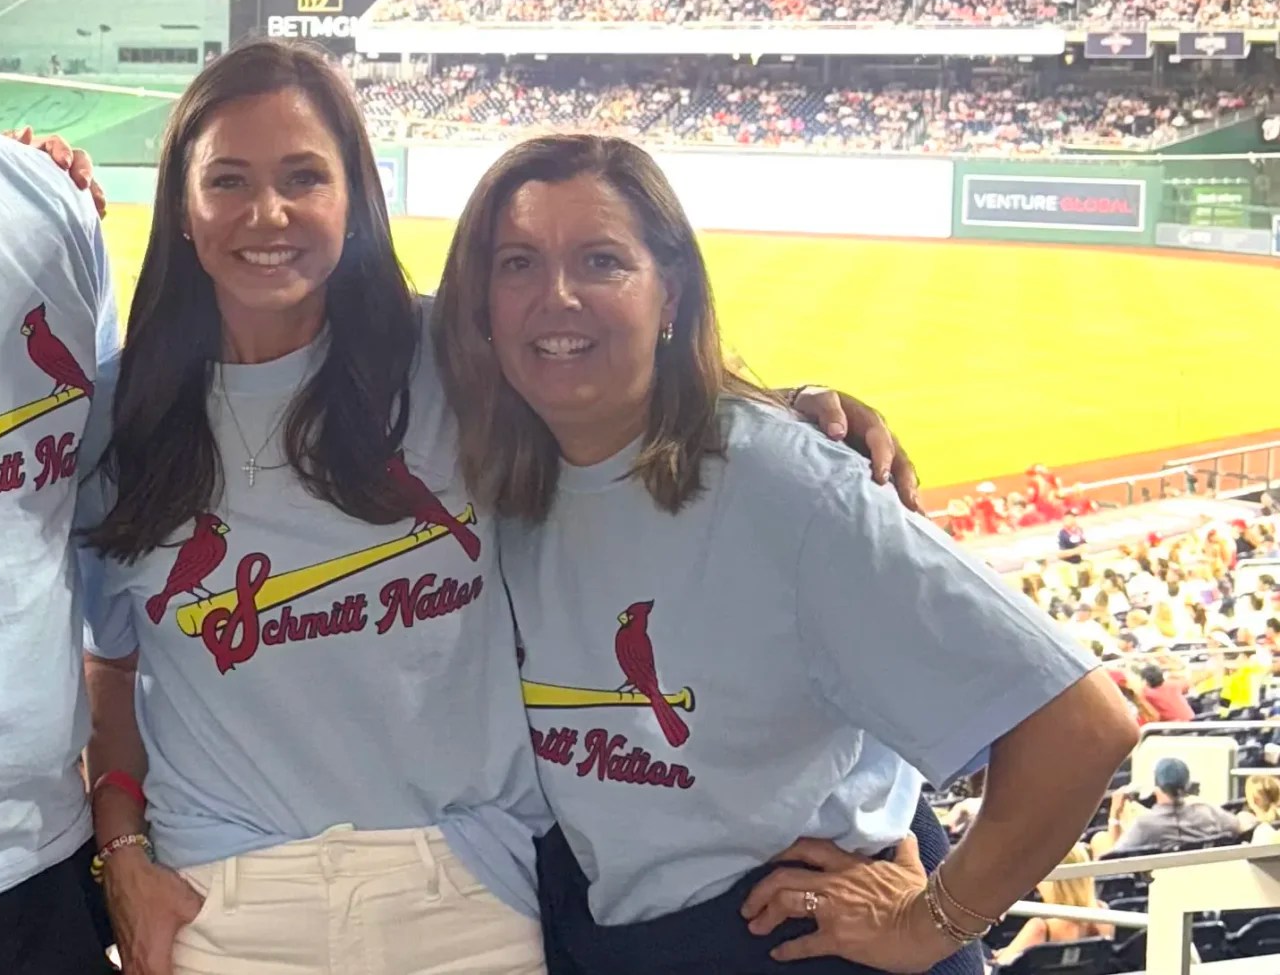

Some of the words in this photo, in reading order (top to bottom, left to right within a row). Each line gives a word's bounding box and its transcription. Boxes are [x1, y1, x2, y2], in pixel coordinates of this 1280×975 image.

[973, 193, 1059, 212] VENTURE
[1060, 196, 1134, 215] GLOBAL
[201, 552, 368, 675] Schmitt
[374, 573, 484, 635] Nation
[575, 728, 696, 789] Nation
